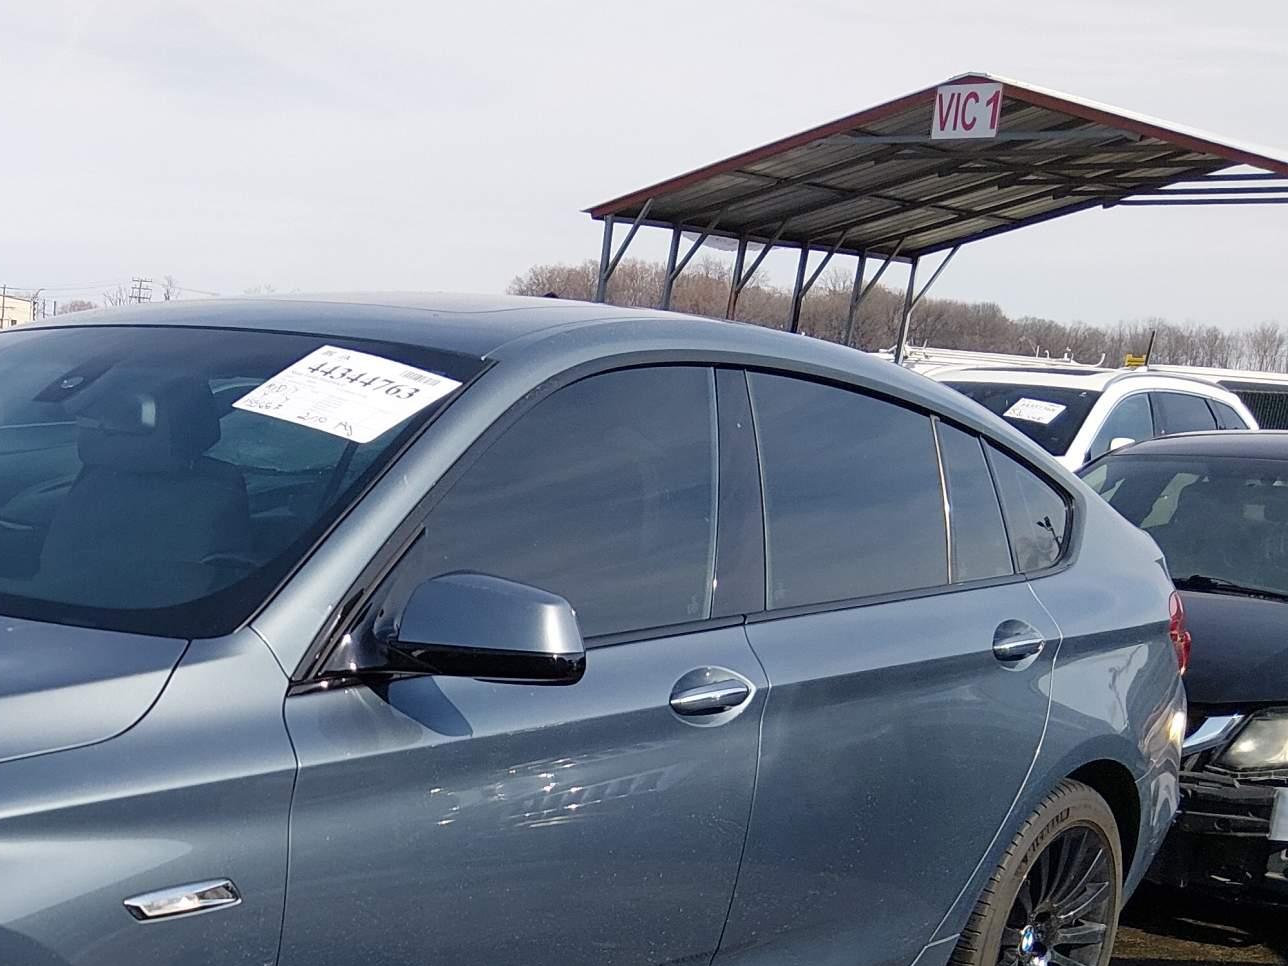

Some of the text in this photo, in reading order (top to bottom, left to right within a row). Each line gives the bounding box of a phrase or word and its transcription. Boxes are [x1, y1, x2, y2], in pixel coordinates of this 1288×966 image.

[938, 90, 1001, 131] VIC 1
[308, 361, 421, 399] 44344763
